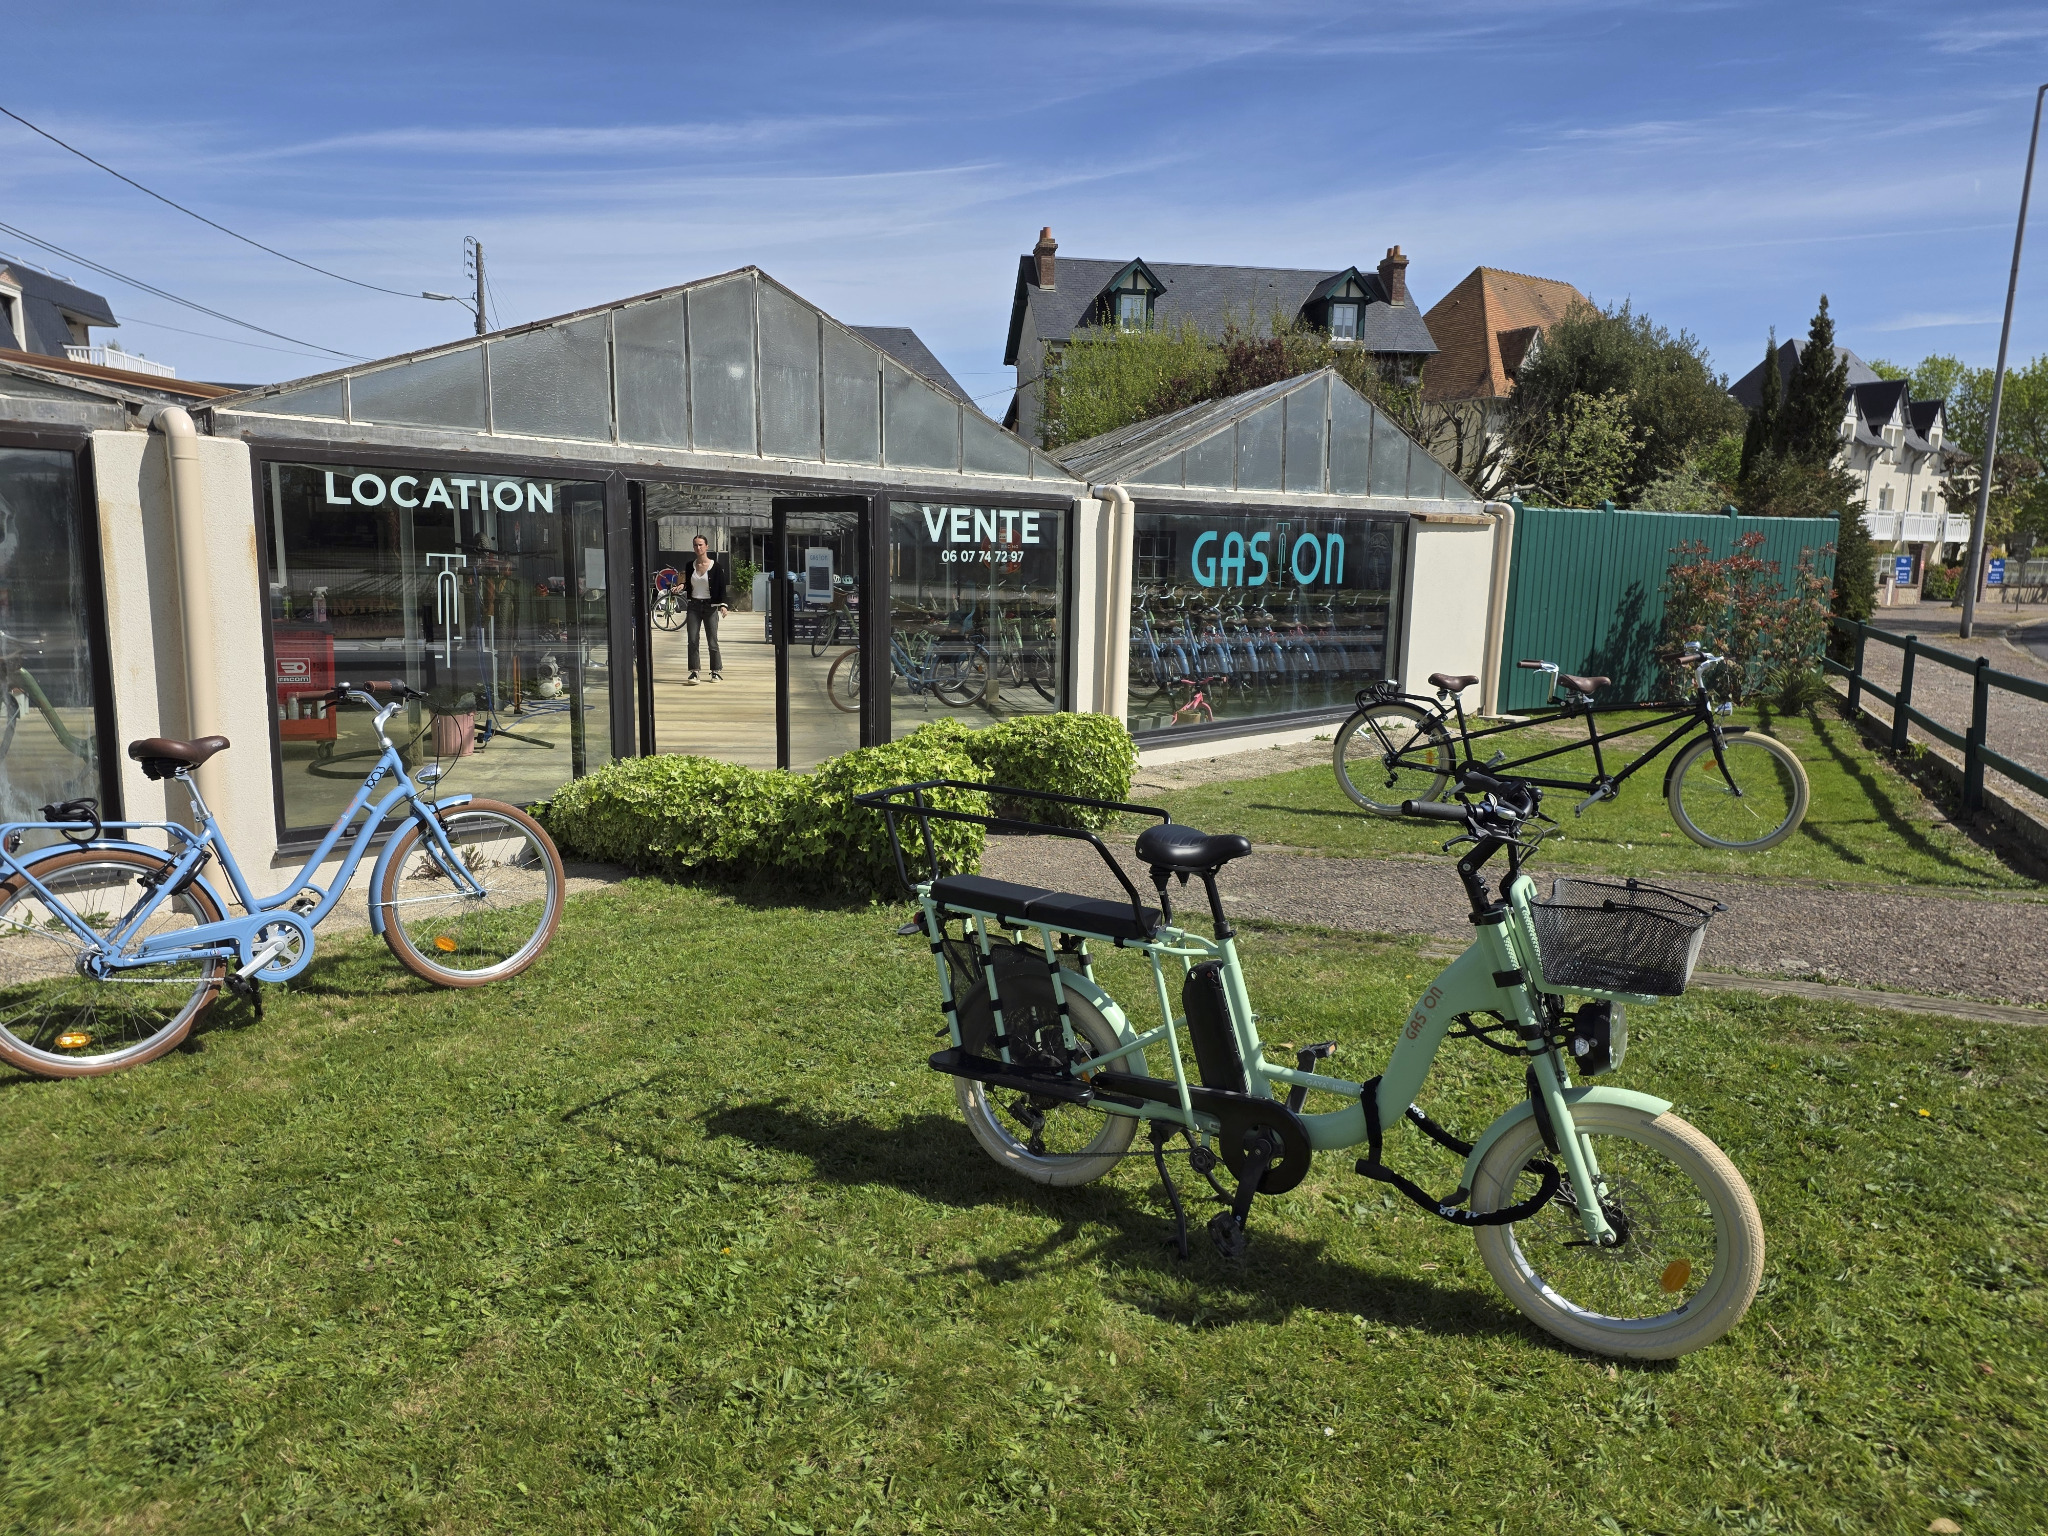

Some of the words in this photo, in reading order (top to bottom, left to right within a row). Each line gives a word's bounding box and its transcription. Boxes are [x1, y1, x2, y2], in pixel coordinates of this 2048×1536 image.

[325, 471, 553, 513] LOCATION
[922, 506, 1040, 543] VENTE
[941, 550, 957, 562] 06
[961, 550, 975, 562] 07
[979, 550, 991, 562] 74
[995, 550, 1008, 562] 72
[1010, 550, 1024, 562] 97
[365, 766, 386, 789] 1903
[1332, 1085, 1355, 1095] ARCADE
